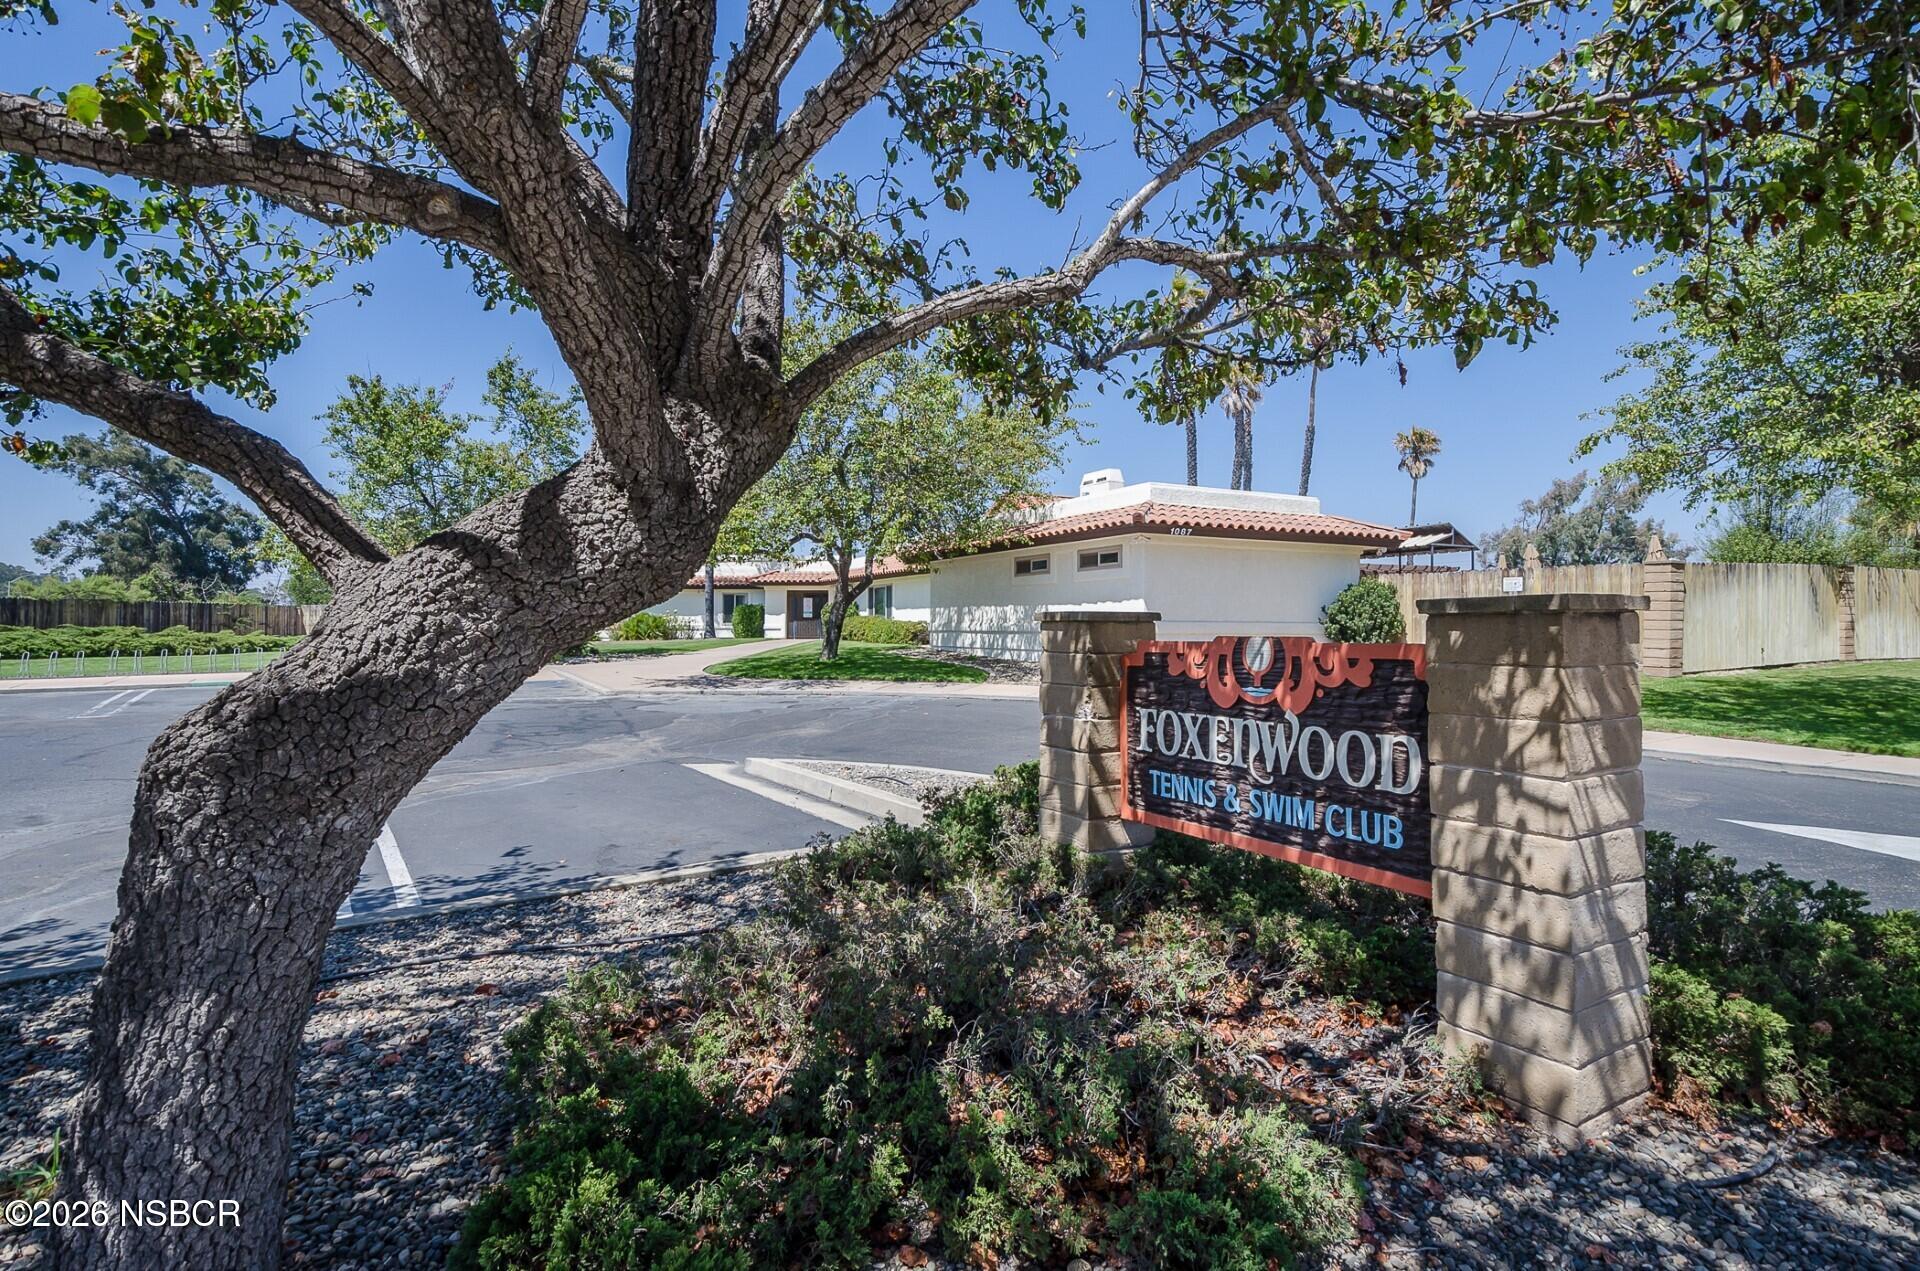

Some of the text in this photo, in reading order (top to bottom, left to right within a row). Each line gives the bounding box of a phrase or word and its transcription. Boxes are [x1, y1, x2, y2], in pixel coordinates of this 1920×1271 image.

[1170, 527, 1193, 536] 1087
[1149, 769, 1404, 850] TENNIS & SWIM CLUB
